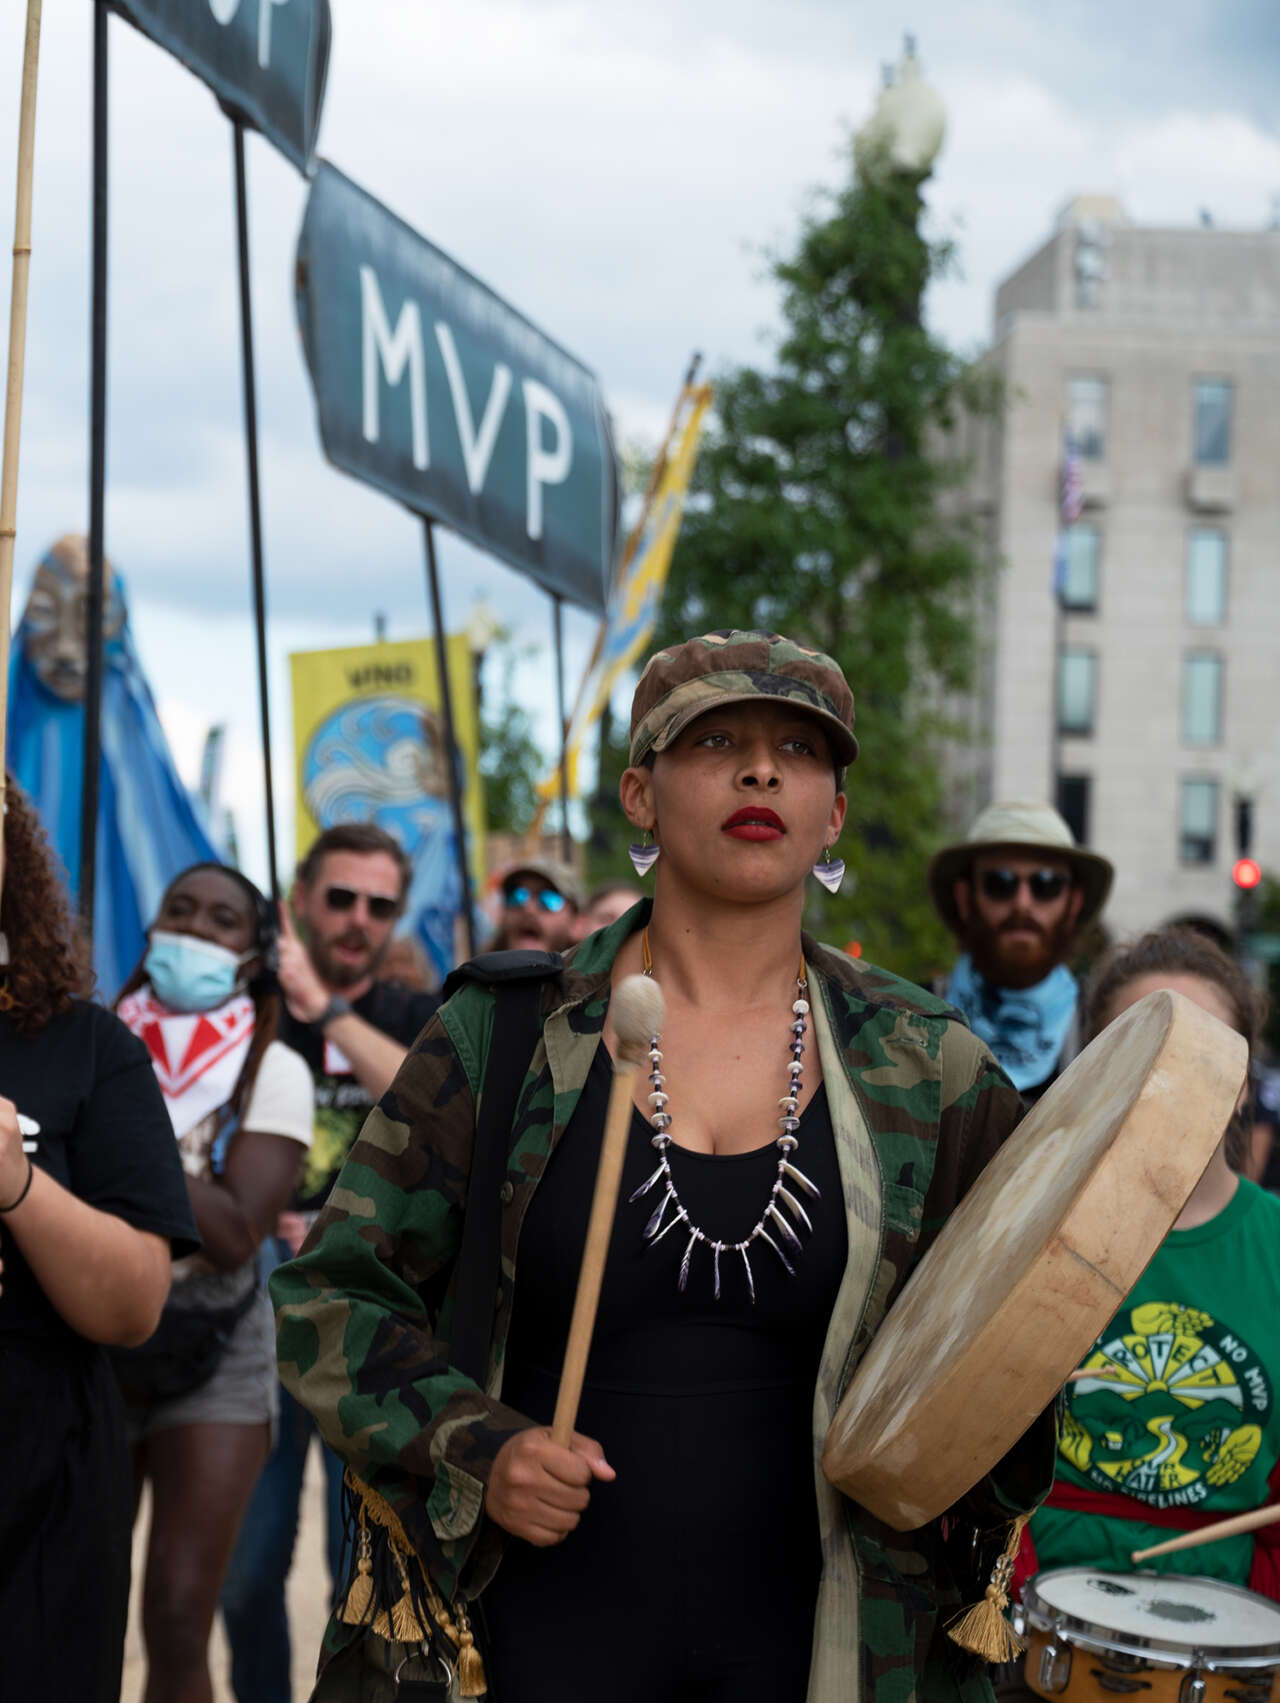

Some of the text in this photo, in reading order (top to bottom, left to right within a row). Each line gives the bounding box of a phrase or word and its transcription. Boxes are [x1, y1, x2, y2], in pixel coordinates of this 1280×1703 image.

[360, 264, 574, 541] MVP
[1220, 1333, 1268, 1411] NO MVP
